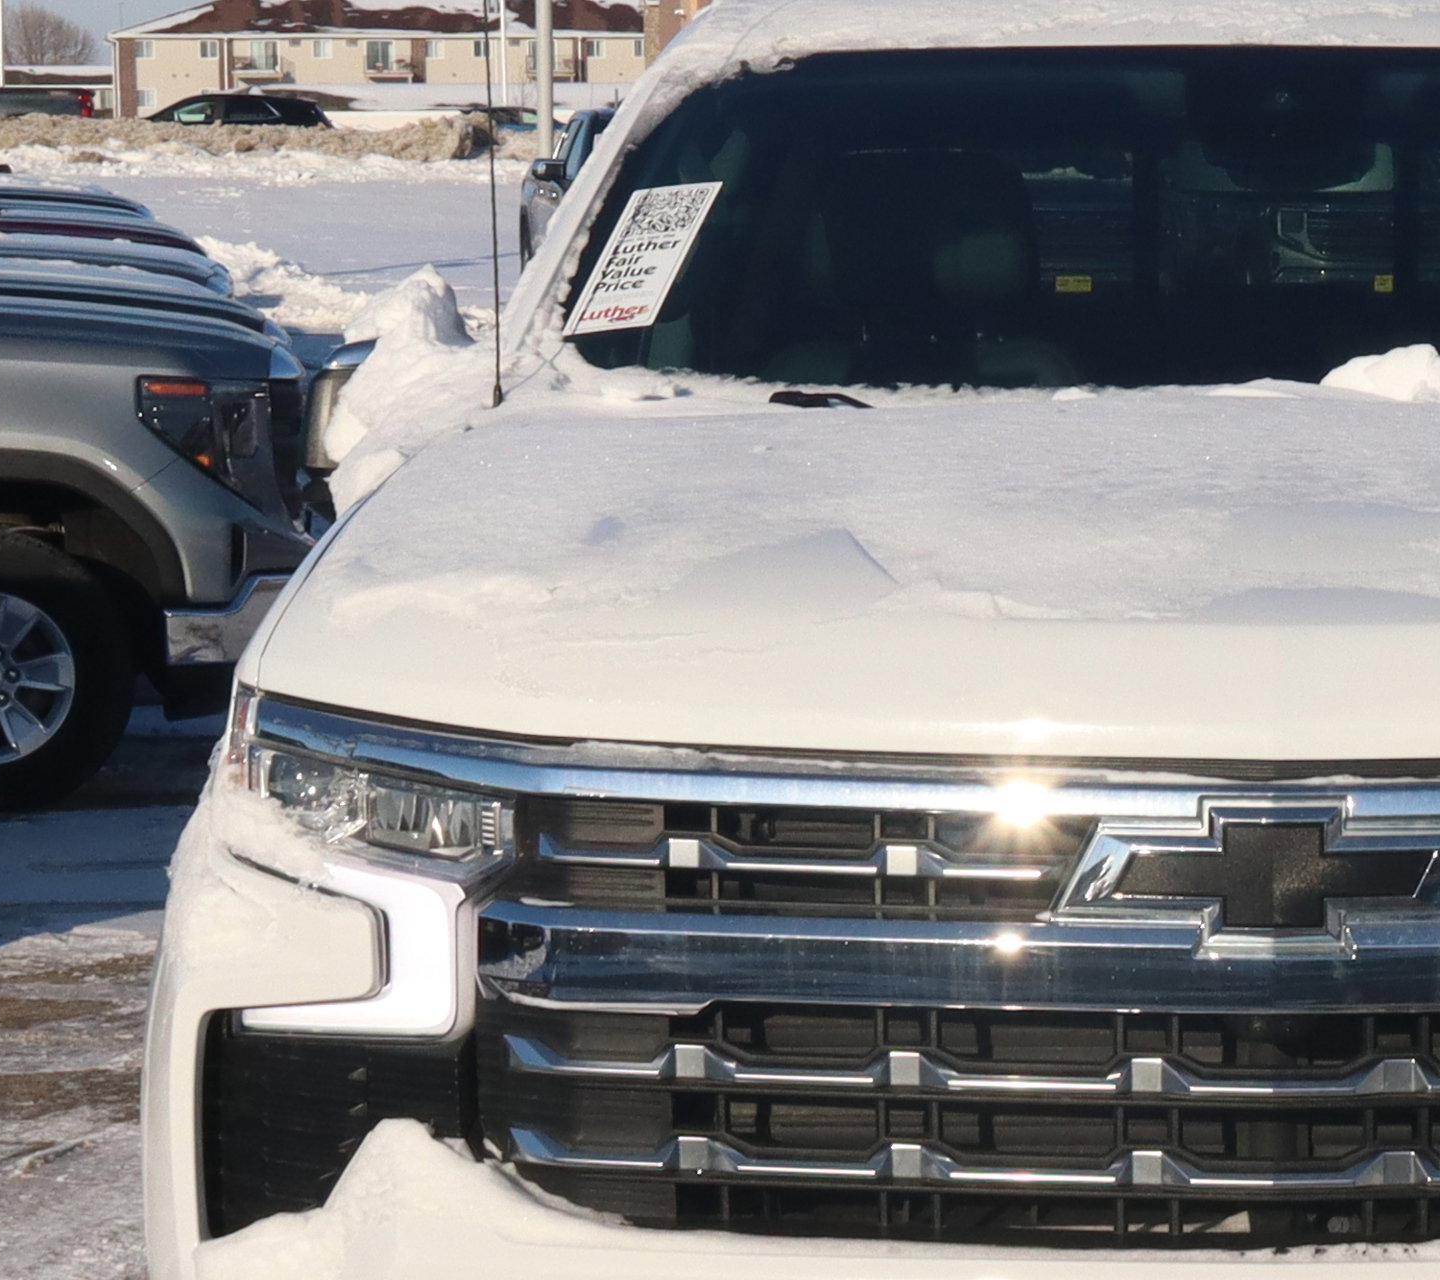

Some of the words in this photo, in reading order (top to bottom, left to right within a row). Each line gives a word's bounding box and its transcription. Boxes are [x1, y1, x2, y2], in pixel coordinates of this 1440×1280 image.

[611, 237, 682, 257] Luther
[605, 255, 642, 269] Fair
[600, 264, 658, 281] Value
[593, 278, 646, 295] Price
[579, 303, 647, 322] Luther
